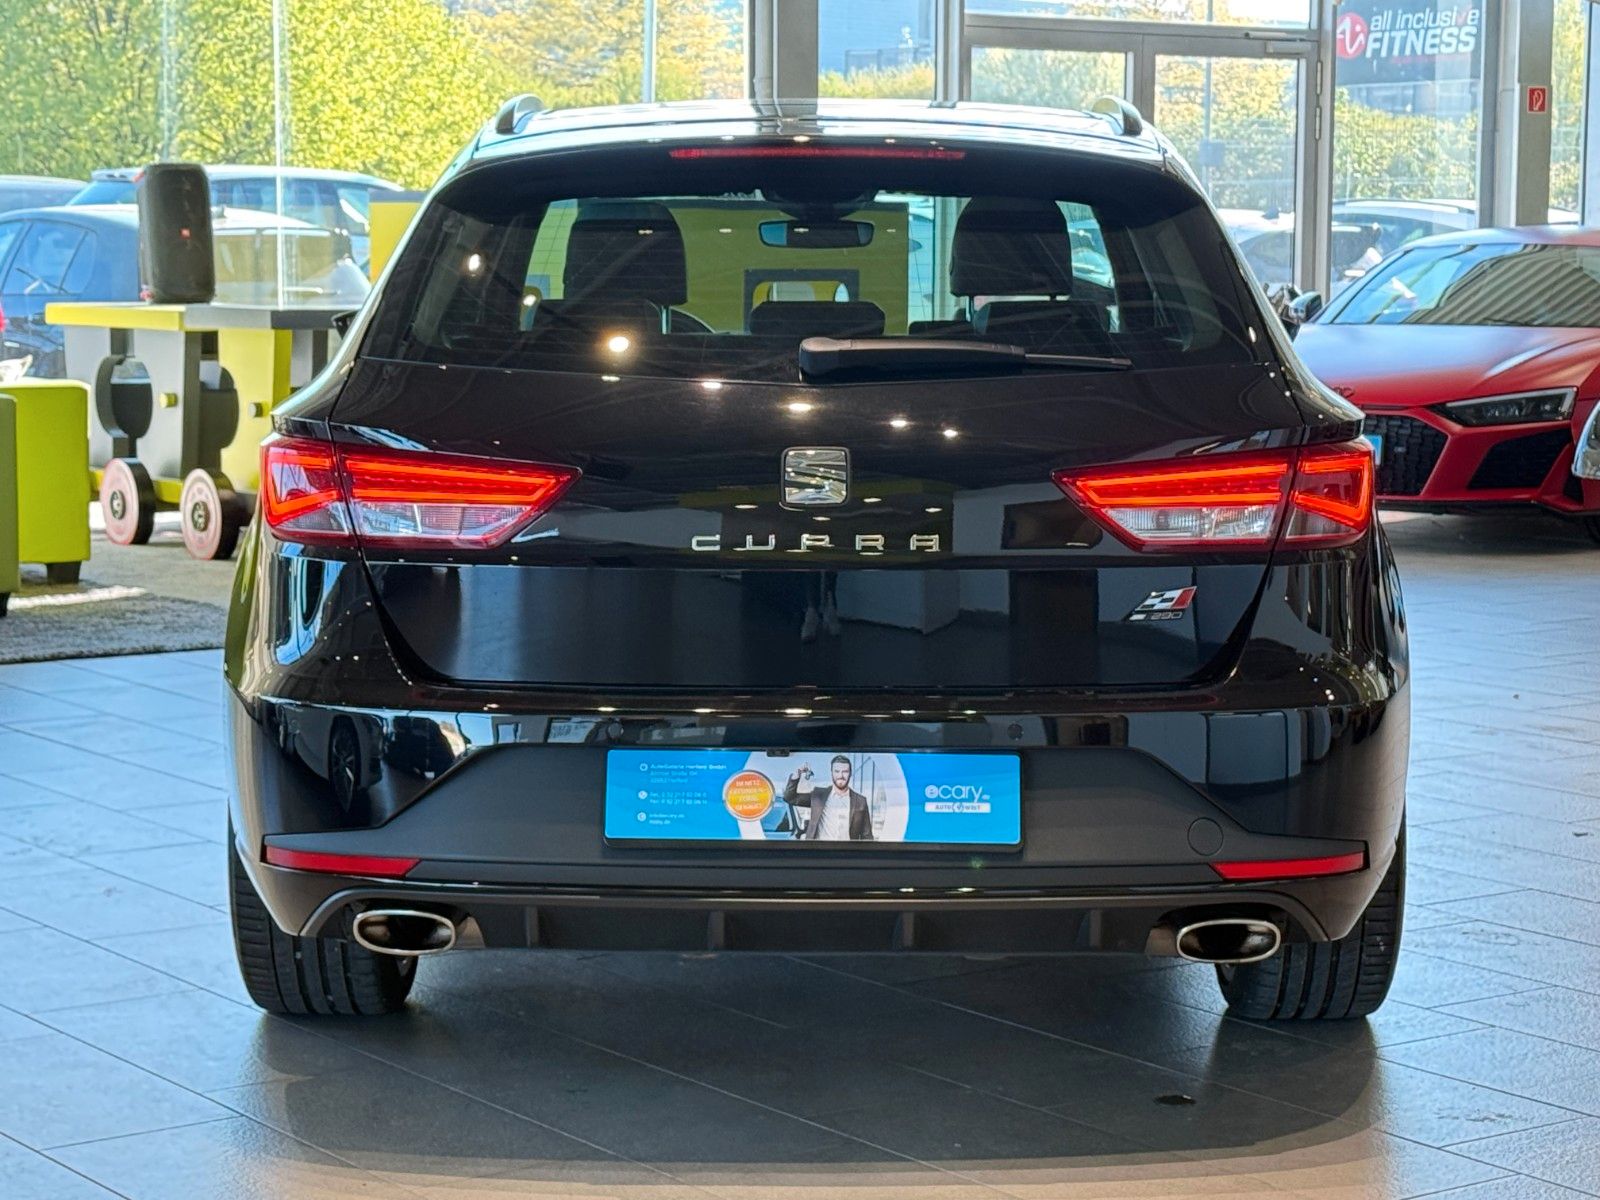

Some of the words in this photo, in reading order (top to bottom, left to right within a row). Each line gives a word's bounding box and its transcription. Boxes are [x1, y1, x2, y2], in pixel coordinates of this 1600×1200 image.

[1370, 10, 1392, 31] all
[1396, 5, 1480, 30] inclusive
[1365, 25, 1478, 58] FITNESS
[691, 533, 940, 551] CUPRA
[1150, 611, 1183, 620] 290
